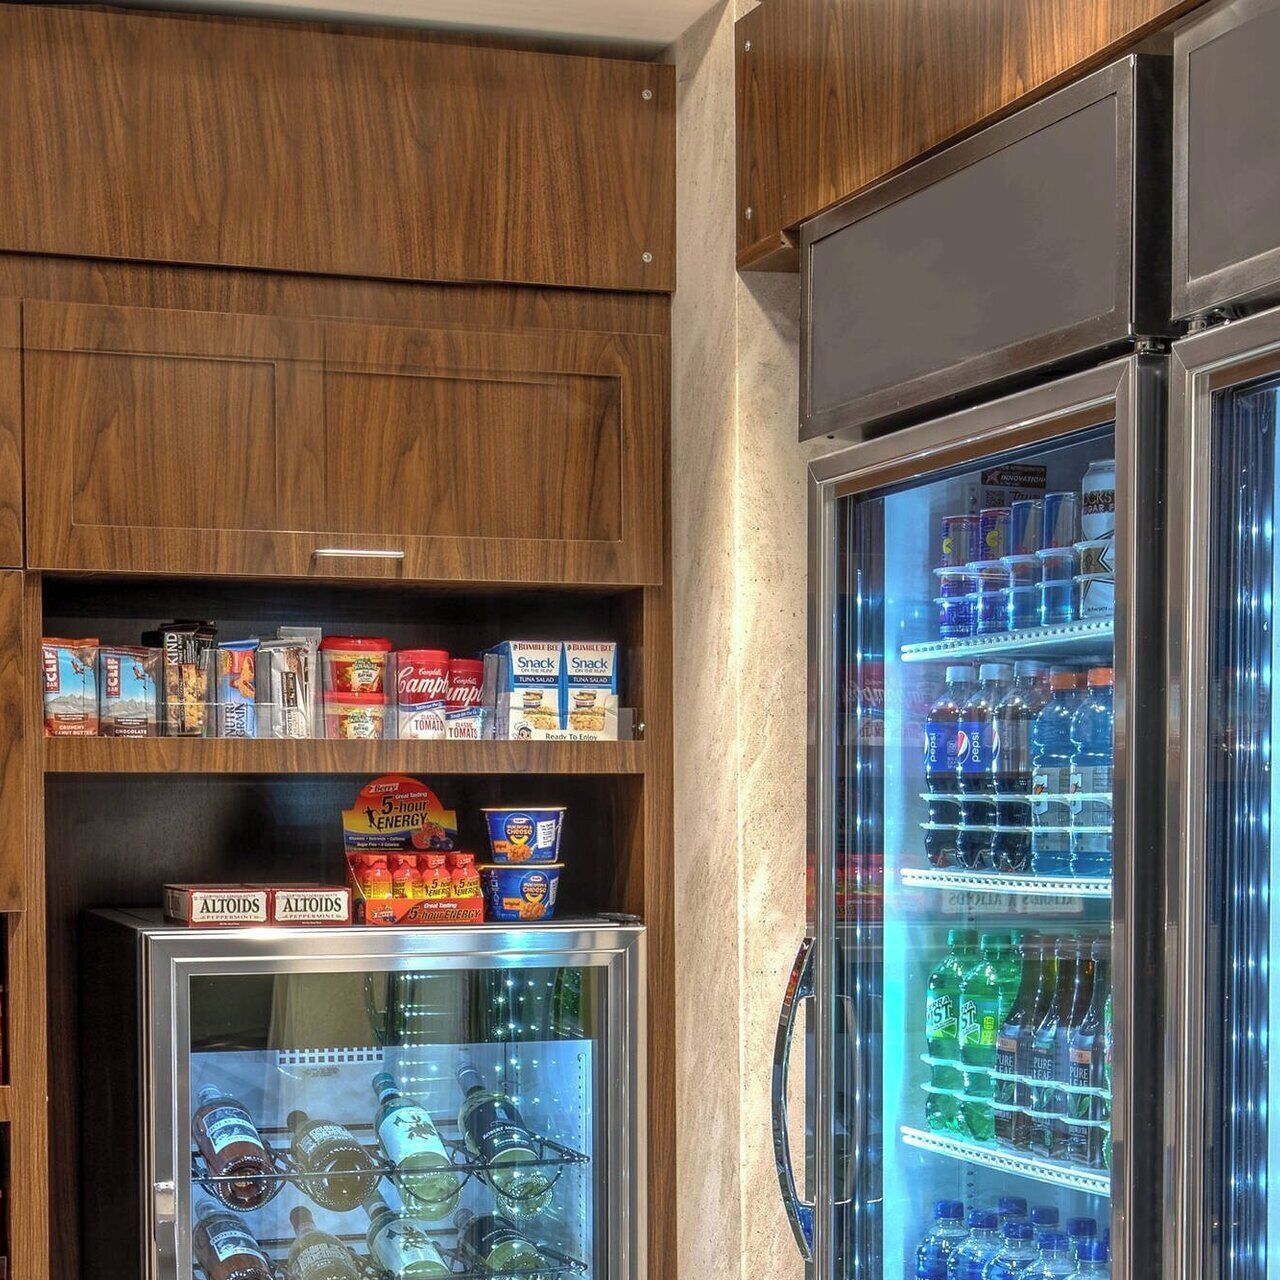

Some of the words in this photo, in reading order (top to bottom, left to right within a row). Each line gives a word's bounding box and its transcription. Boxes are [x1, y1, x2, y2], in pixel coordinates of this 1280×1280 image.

[1001, 475, 1045, 483] INNOVATION
[167, 633, 179, 666] KIND
[45, 650, 58, 682] CLIF
[518, 657, 554, 669] Snack
[572, 657, 608, 669] Snack
[107, 658, 119, 686] CLIF
[929, 732, 938, 762] pepsi
[971, 732, 981, 762] pepsi
[381, 795, 428, 814] 5-hour
[377, 813, 428, 831] ENERGY
[200, 898, 260, 914] ALTOIDS
[283, 897, 342, 913] ALTOIDS
[409, 907, 443, 919] 5-hour
[444, 909, 480, 919] ENERGY
[996, 1051, 1013, 1065] PURE
[1033, 1057, 1052, 1070] PURE
[1070, 1068, 1088, 1080] PURE
